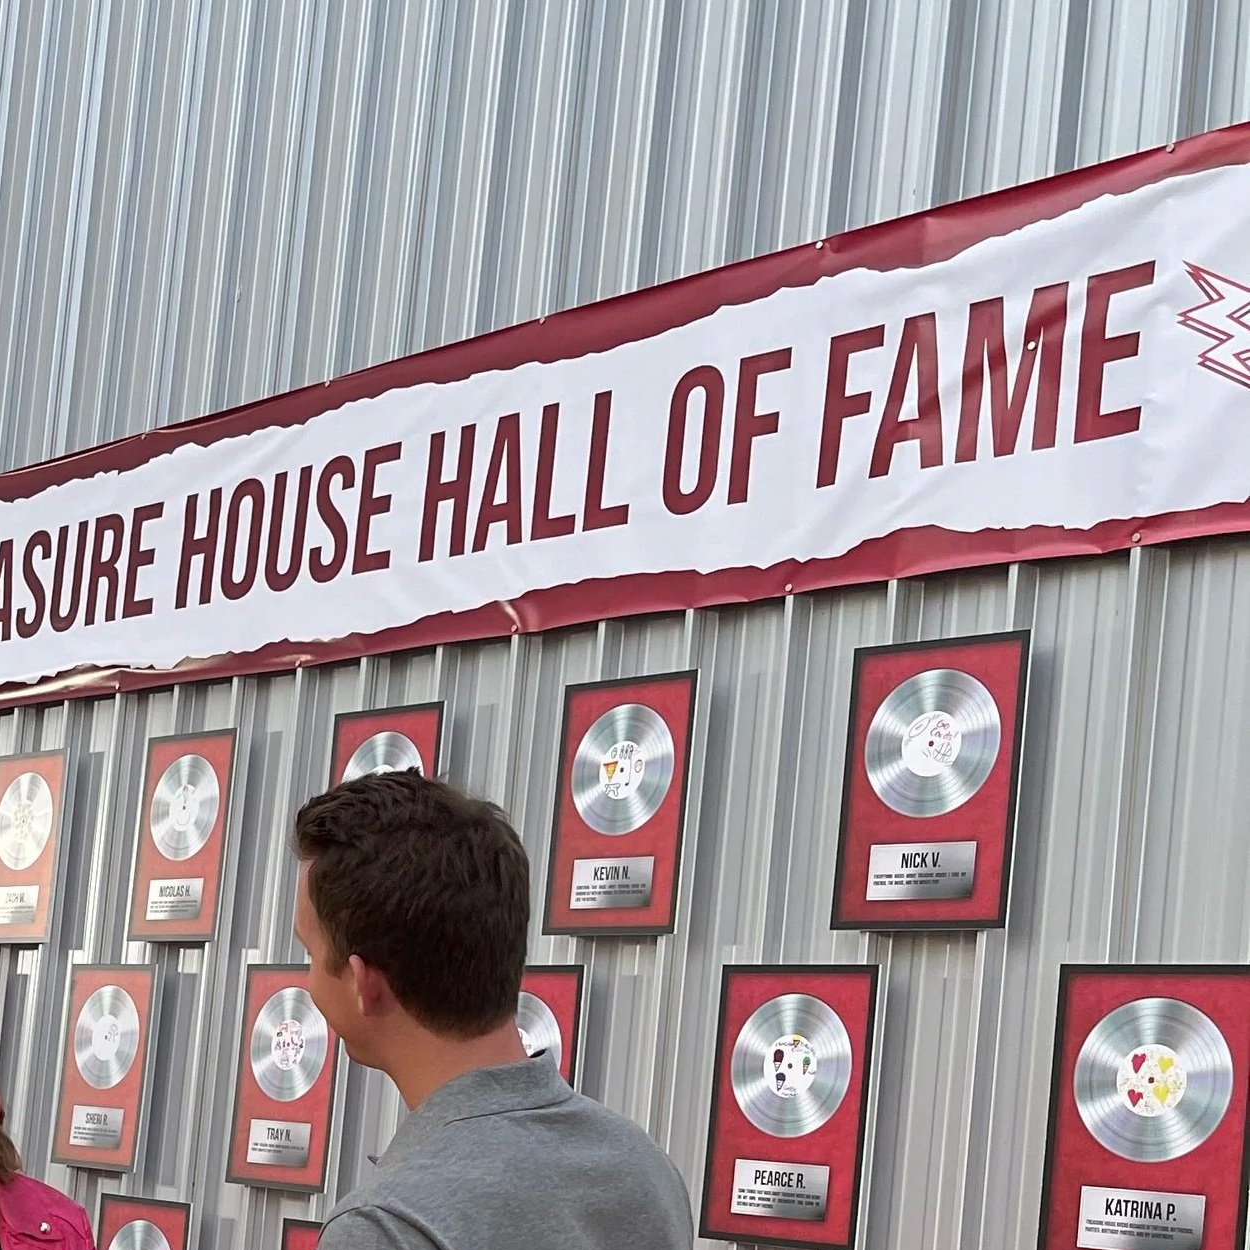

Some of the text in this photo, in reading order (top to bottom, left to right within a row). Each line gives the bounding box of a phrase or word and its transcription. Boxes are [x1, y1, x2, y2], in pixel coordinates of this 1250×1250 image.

[175, 443, 402, 609] HOUSE
[418, 390, 630, 562] HALL
[661, 346, 793, 516] OF
[816, 260, 1156, 489] FAME
[900, 851, 941, 869] NICK V.
[593, 865, 631, 881] KEVIN N.
[158, 885, 184, 898] NICOLAS
[266, 1127, 285, 1141] TRAY
[754, 1169, 806, 1190] PEARCE R.
[1104, 1197, 1177, 1222] KATRINA P.
